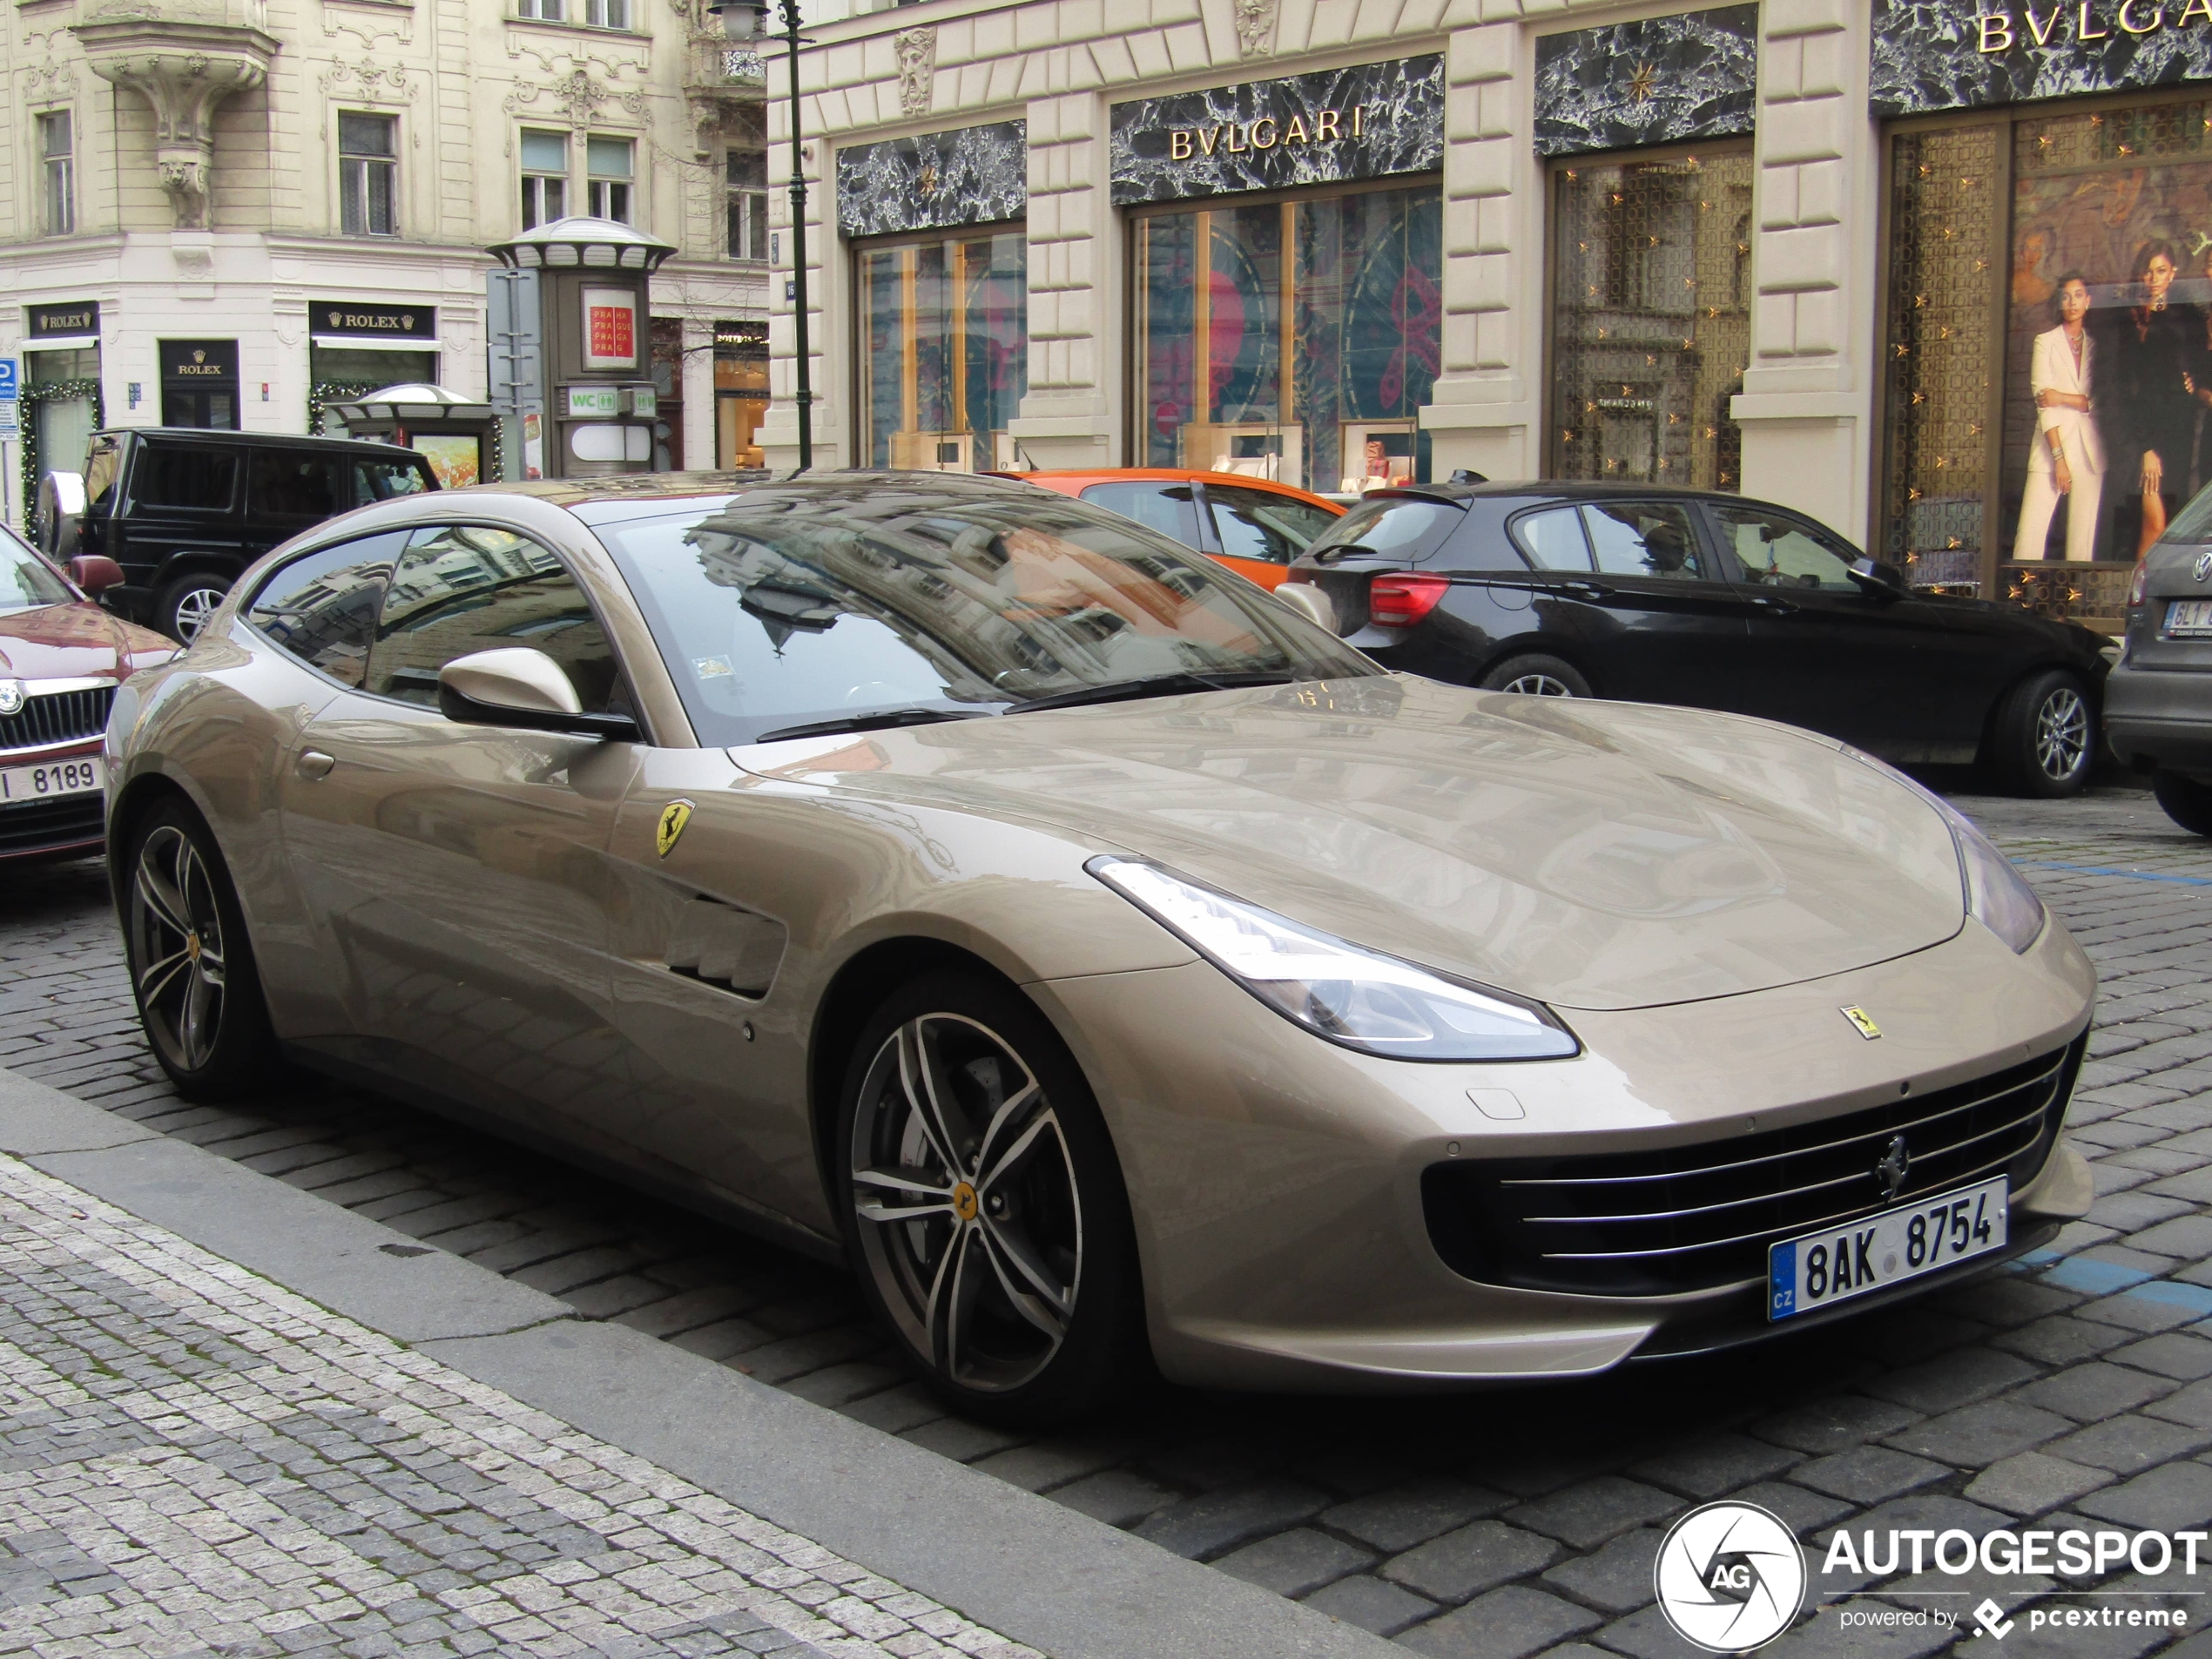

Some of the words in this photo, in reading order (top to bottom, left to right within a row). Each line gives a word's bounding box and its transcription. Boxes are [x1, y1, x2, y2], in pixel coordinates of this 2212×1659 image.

[1171, 106, 1365, 160] BVLGARI
[787, 285, 795, 296] 16
[50, 315, 82, 328] ROLEX
[345, 314, 400, 328] ROLEX
[179, 365, 222, 374] ROLEX
[572, 395, 595, 407] WC
[33, 762, 95, 793] 8189
[1806, 1227, 1876, 1298] 8AK
[1906, 1191, 1991, 1267] 8754
[1773, 1291, 1792, 1309] CZ
